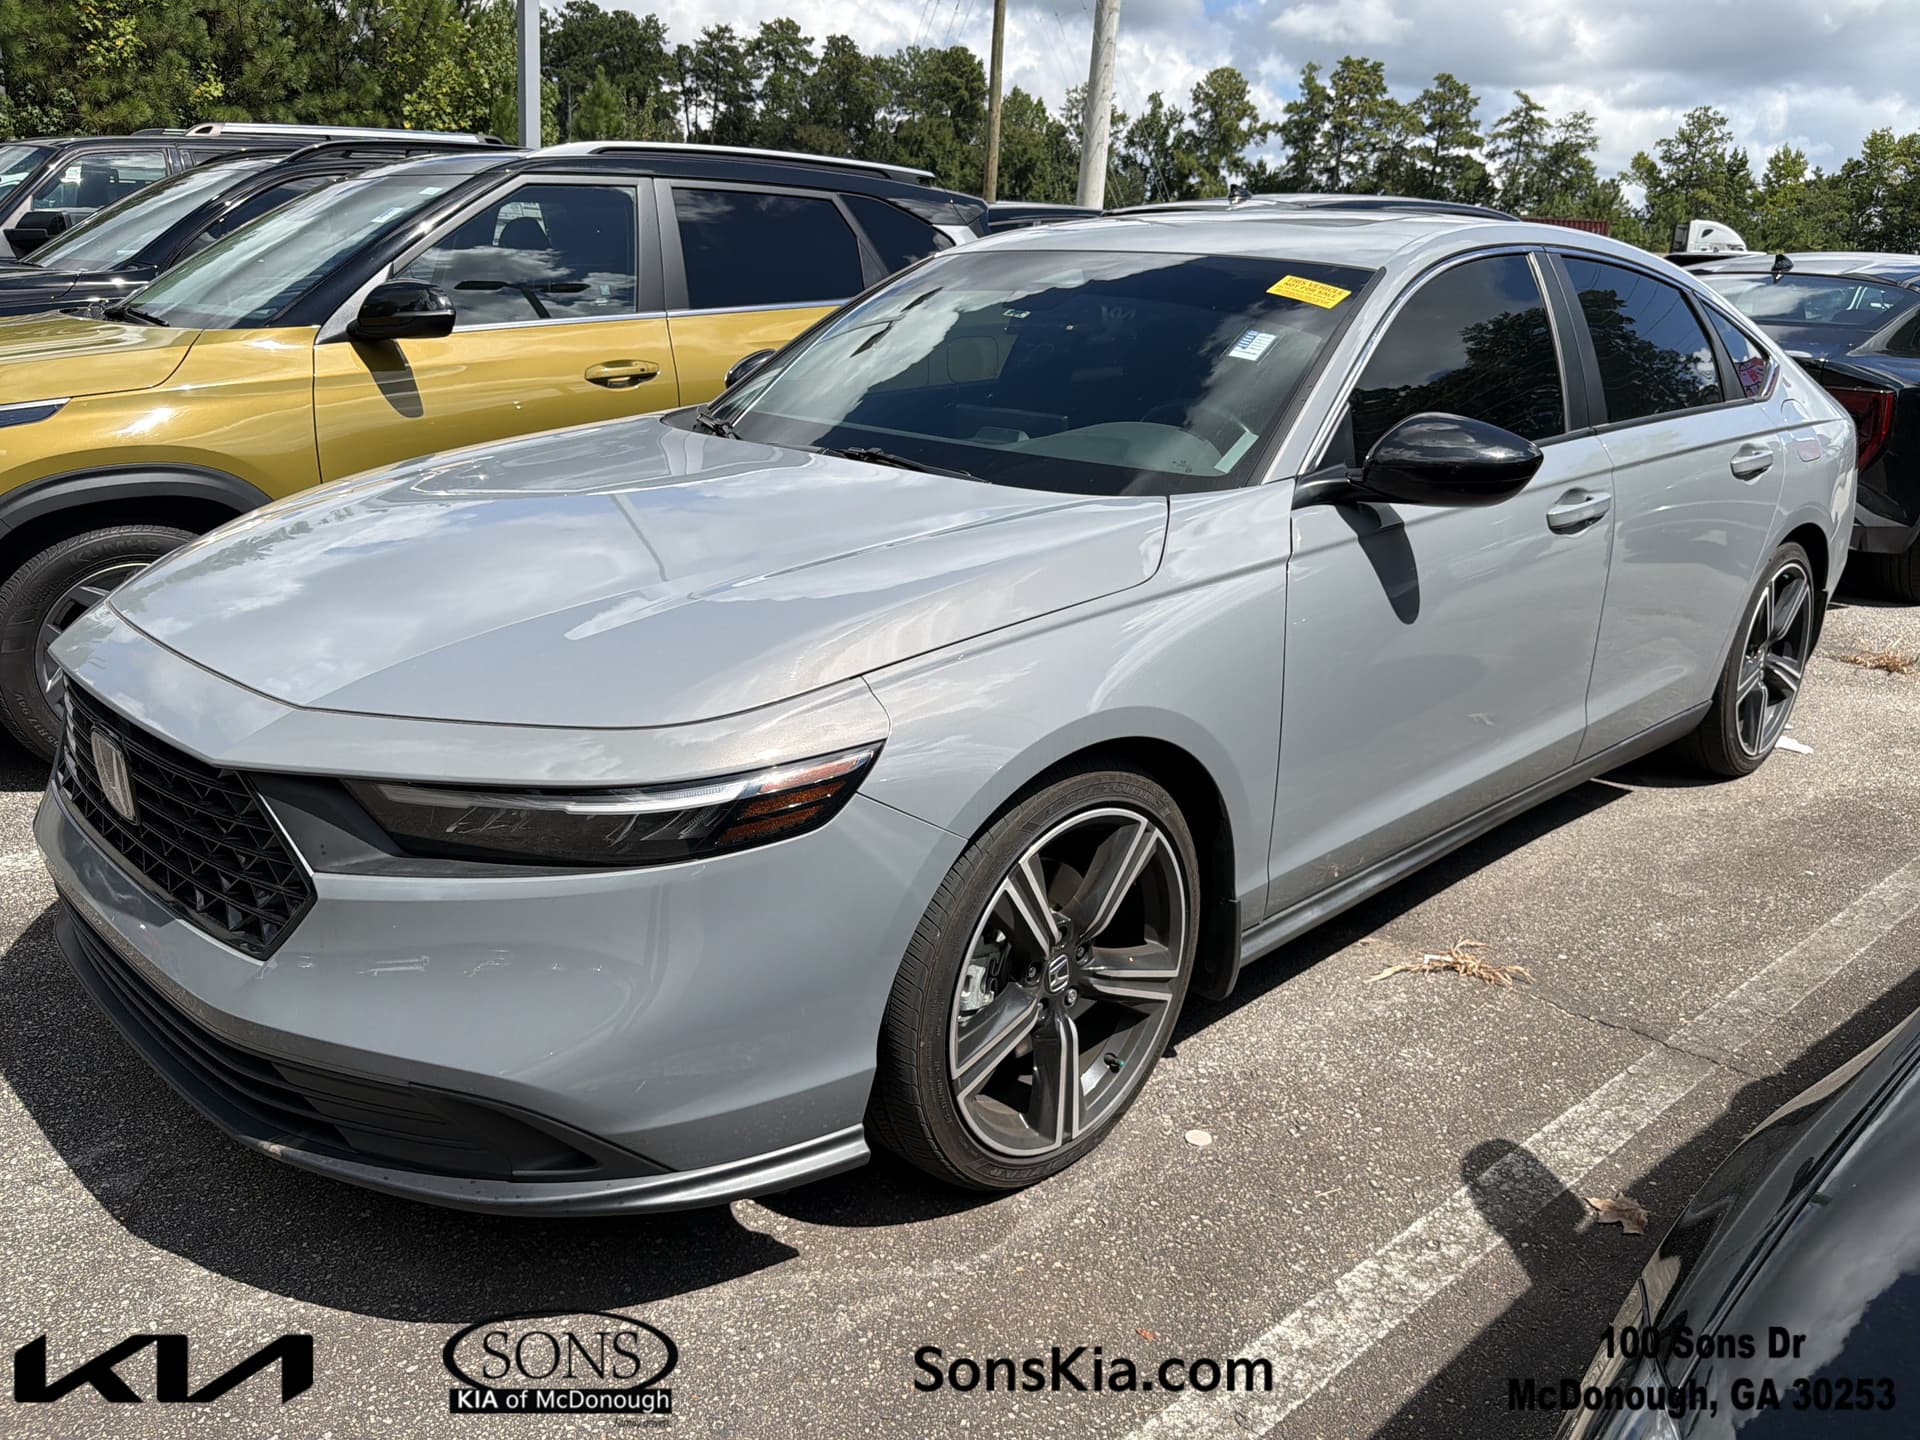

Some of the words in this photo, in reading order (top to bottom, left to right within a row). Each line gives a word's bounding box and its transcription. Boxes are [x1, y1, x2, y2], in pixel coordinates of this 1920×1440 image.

[1287, 277, 1306, 286] THIS
[1308, 282, 1343, 296] VEHICLE
[1318, 291, 1338, 299] SALE
